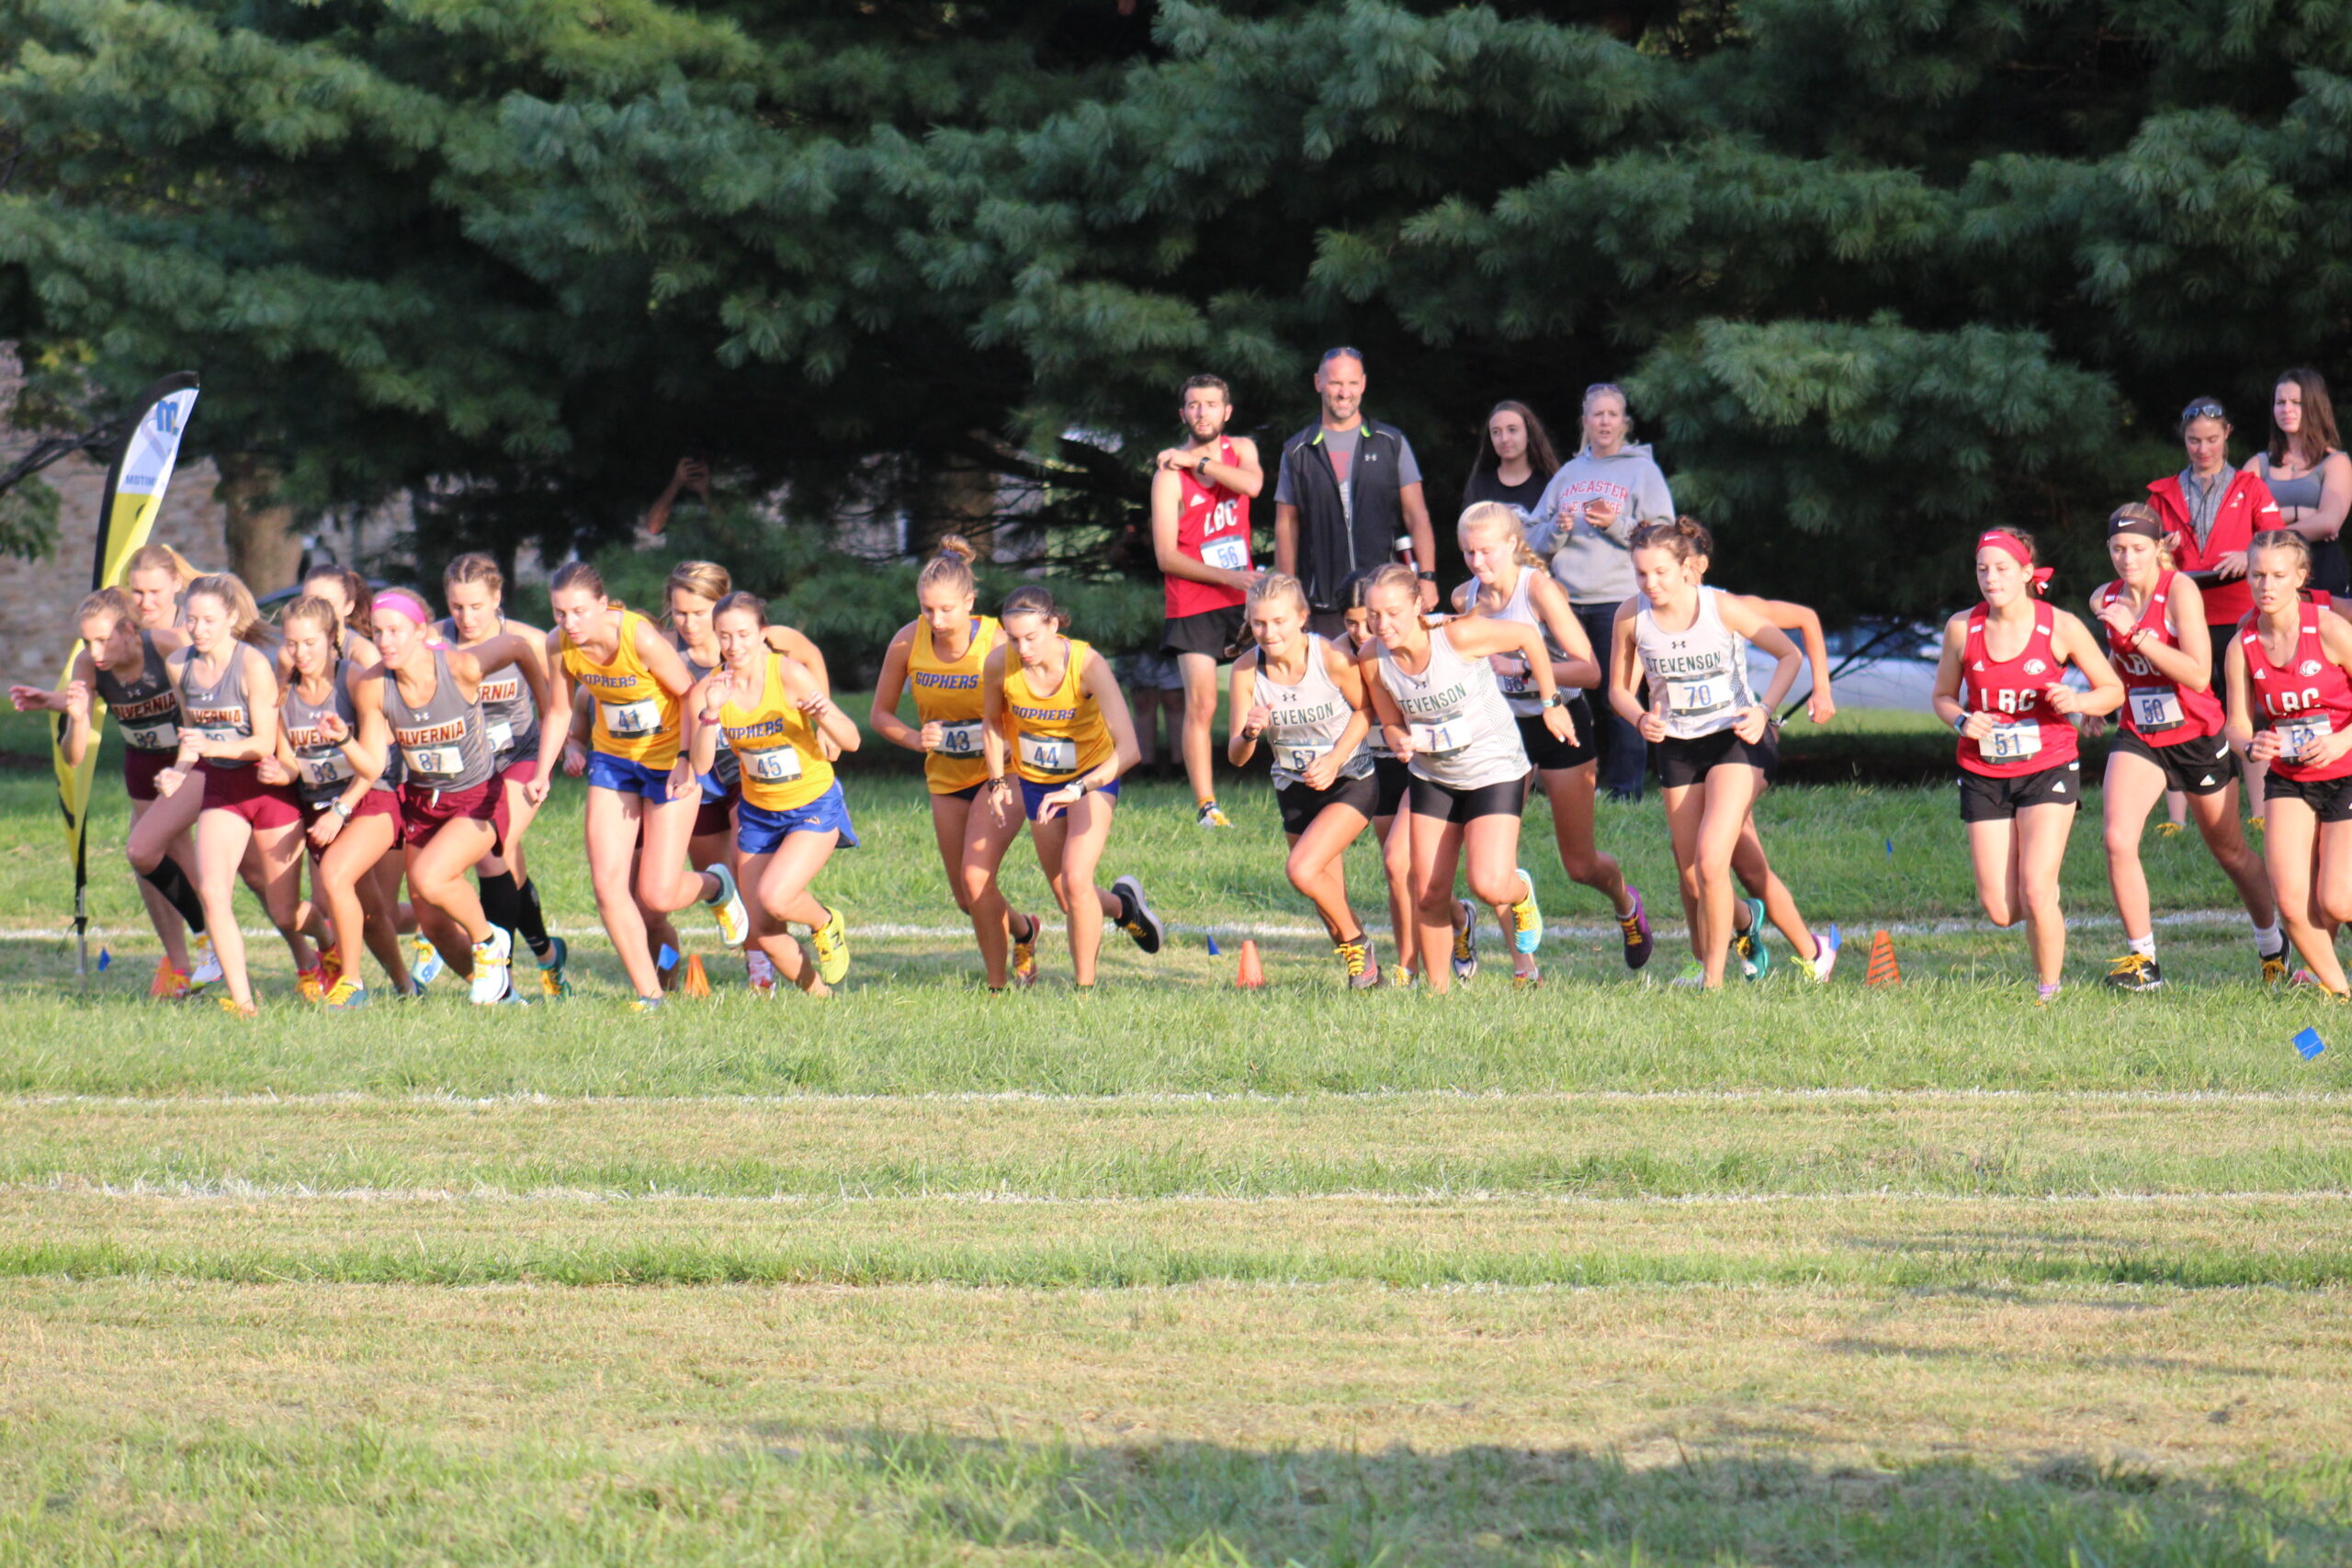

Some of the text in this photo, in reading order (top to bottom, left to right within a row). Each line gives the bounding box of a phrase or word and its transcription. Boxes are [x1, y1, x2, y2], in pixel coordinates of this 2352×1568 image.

[1204, 499, 1238, 537] LBC
[1216, 546, 1238, 569] 56
[1645, 650, 1721, 673] STEVENSON
[915, 671, 980, 690] GOPHERS
[1683, 684, 1712, 708] 70
[618, 708, 642, 731] 41
[1012, 705, 1077, 721] GOPHERS
[1270, 701, 1334, 727] EVENSON
[2142, 698, 2166, 724] 50
[396, 719, 465, 746] ALVERNIA
[945, 729, 970, 751] 43
[1425, 727, 1453, 751] 71
[1994, 732, 2021, 756] 51
[418, 751, 442, 773] 87
[757, 755, 783, 778] 45
[1034, 745, 1059, 768] 44
[1292, 750, 1316, 770] 67
